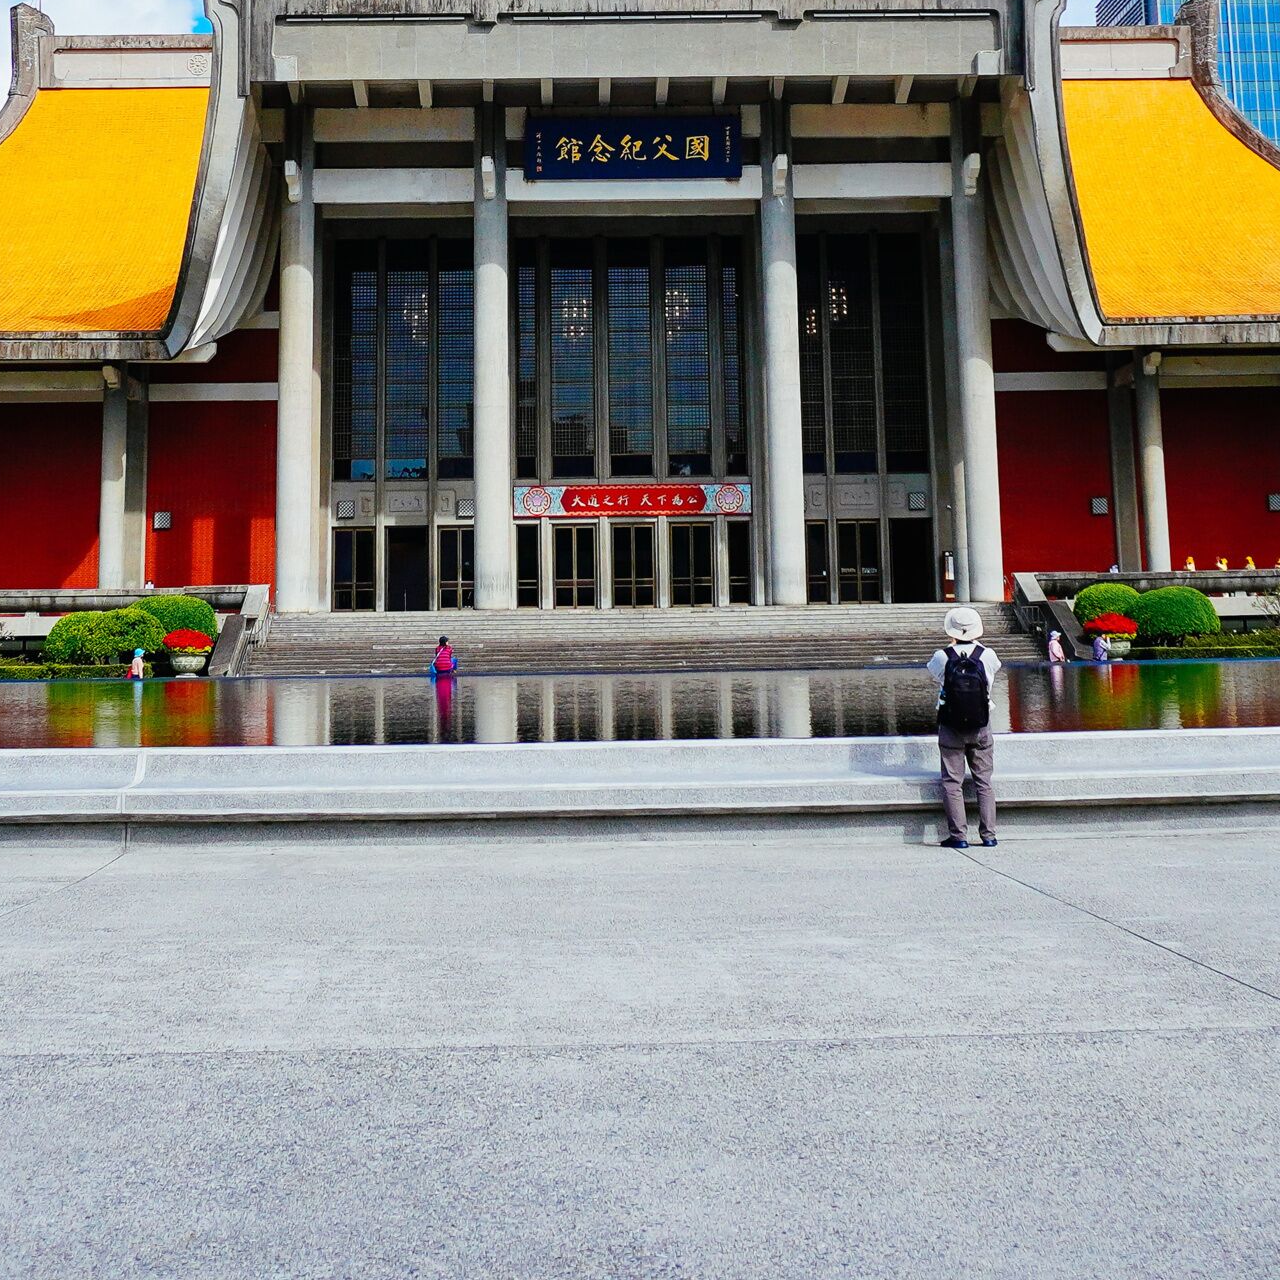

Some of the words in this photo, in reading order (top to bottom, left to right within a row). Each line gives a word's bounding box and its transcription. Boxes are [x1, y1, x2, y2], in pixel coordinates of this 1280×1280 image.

[555, 133, 710, 163] 國父紀念館
[571, 494, 629, 507] 大道之行
[640, 493, 698, 506] 天下為公
